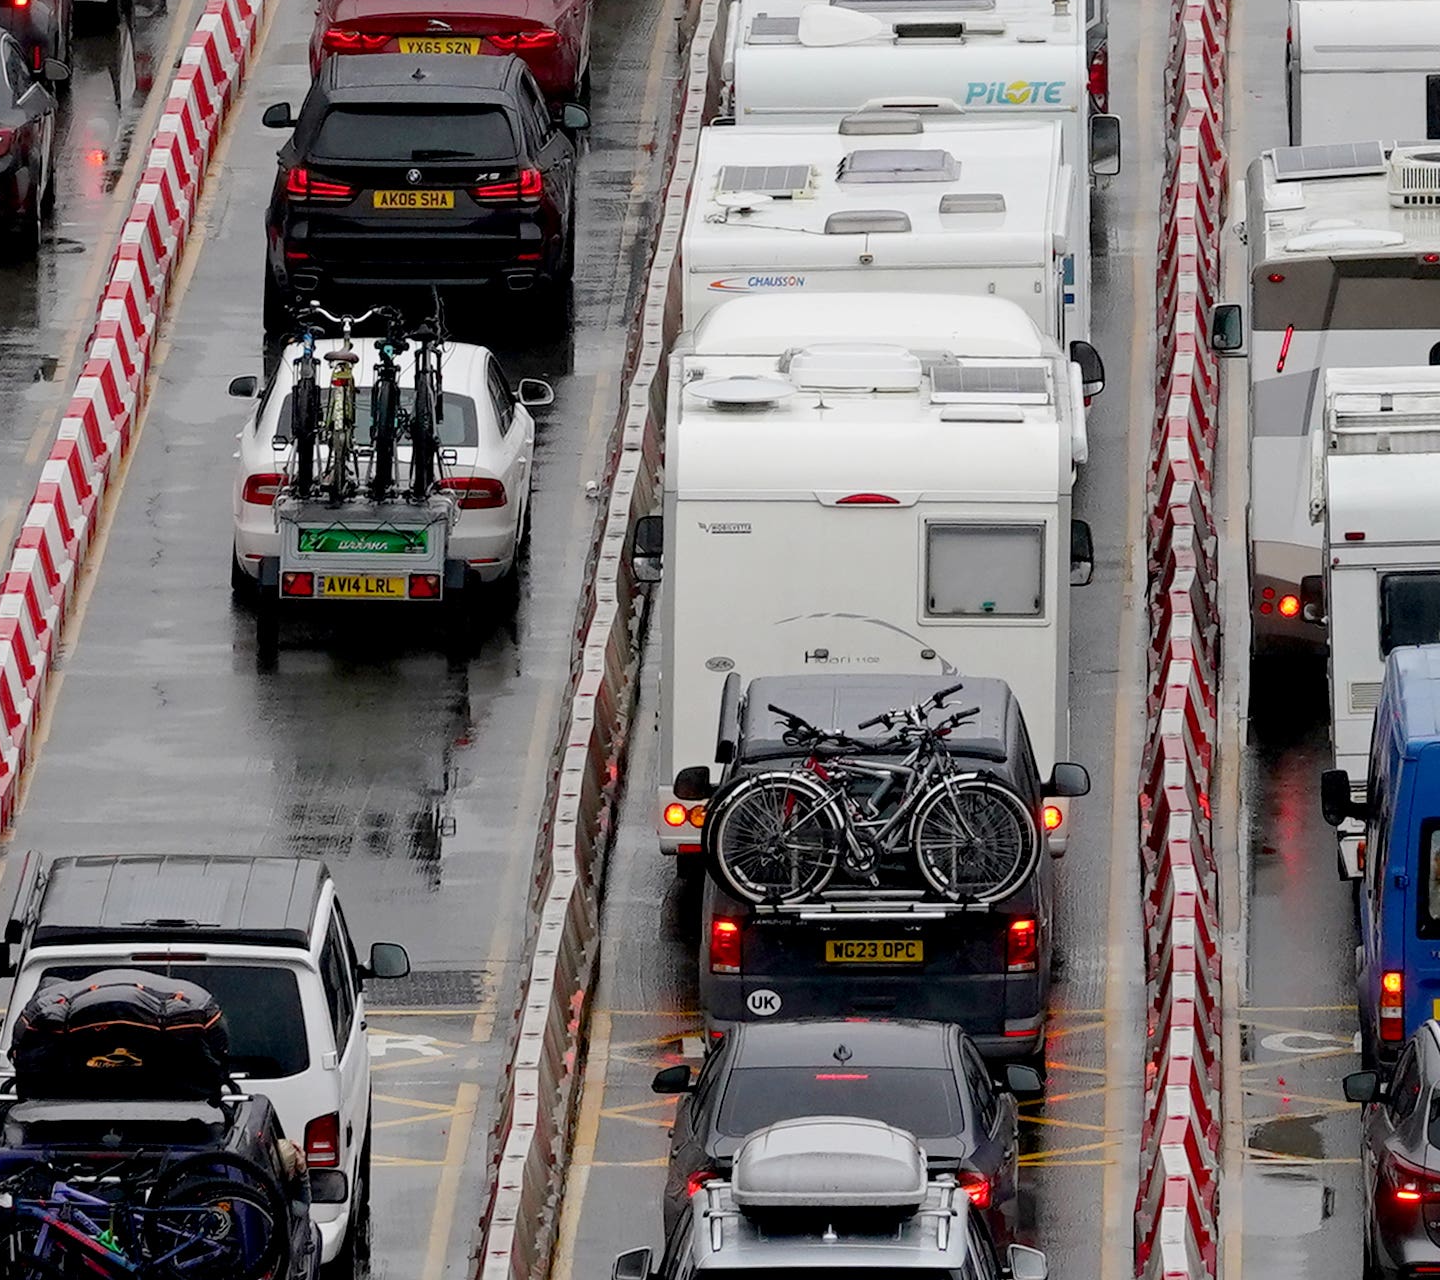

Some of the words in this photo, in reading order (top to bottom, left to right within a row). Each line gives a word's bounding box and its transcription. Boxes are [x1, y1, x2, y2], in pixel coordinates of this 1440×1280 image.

[406, 41, 442, 54] YX65
[445, 41, 472, 54] SZN
[380, 192, 418, 207] AK06
[421, 193, 448, 207] SHA
[748, 276, 805, 287] CHAUSSON
[326, 576, 361, 593] AV14
[365, 576, 395, 593] LRL
[833, 942, 879, 959] WG23
[883, 942, 916, 958] OPC
[751, 996, 775, 1010] UK
